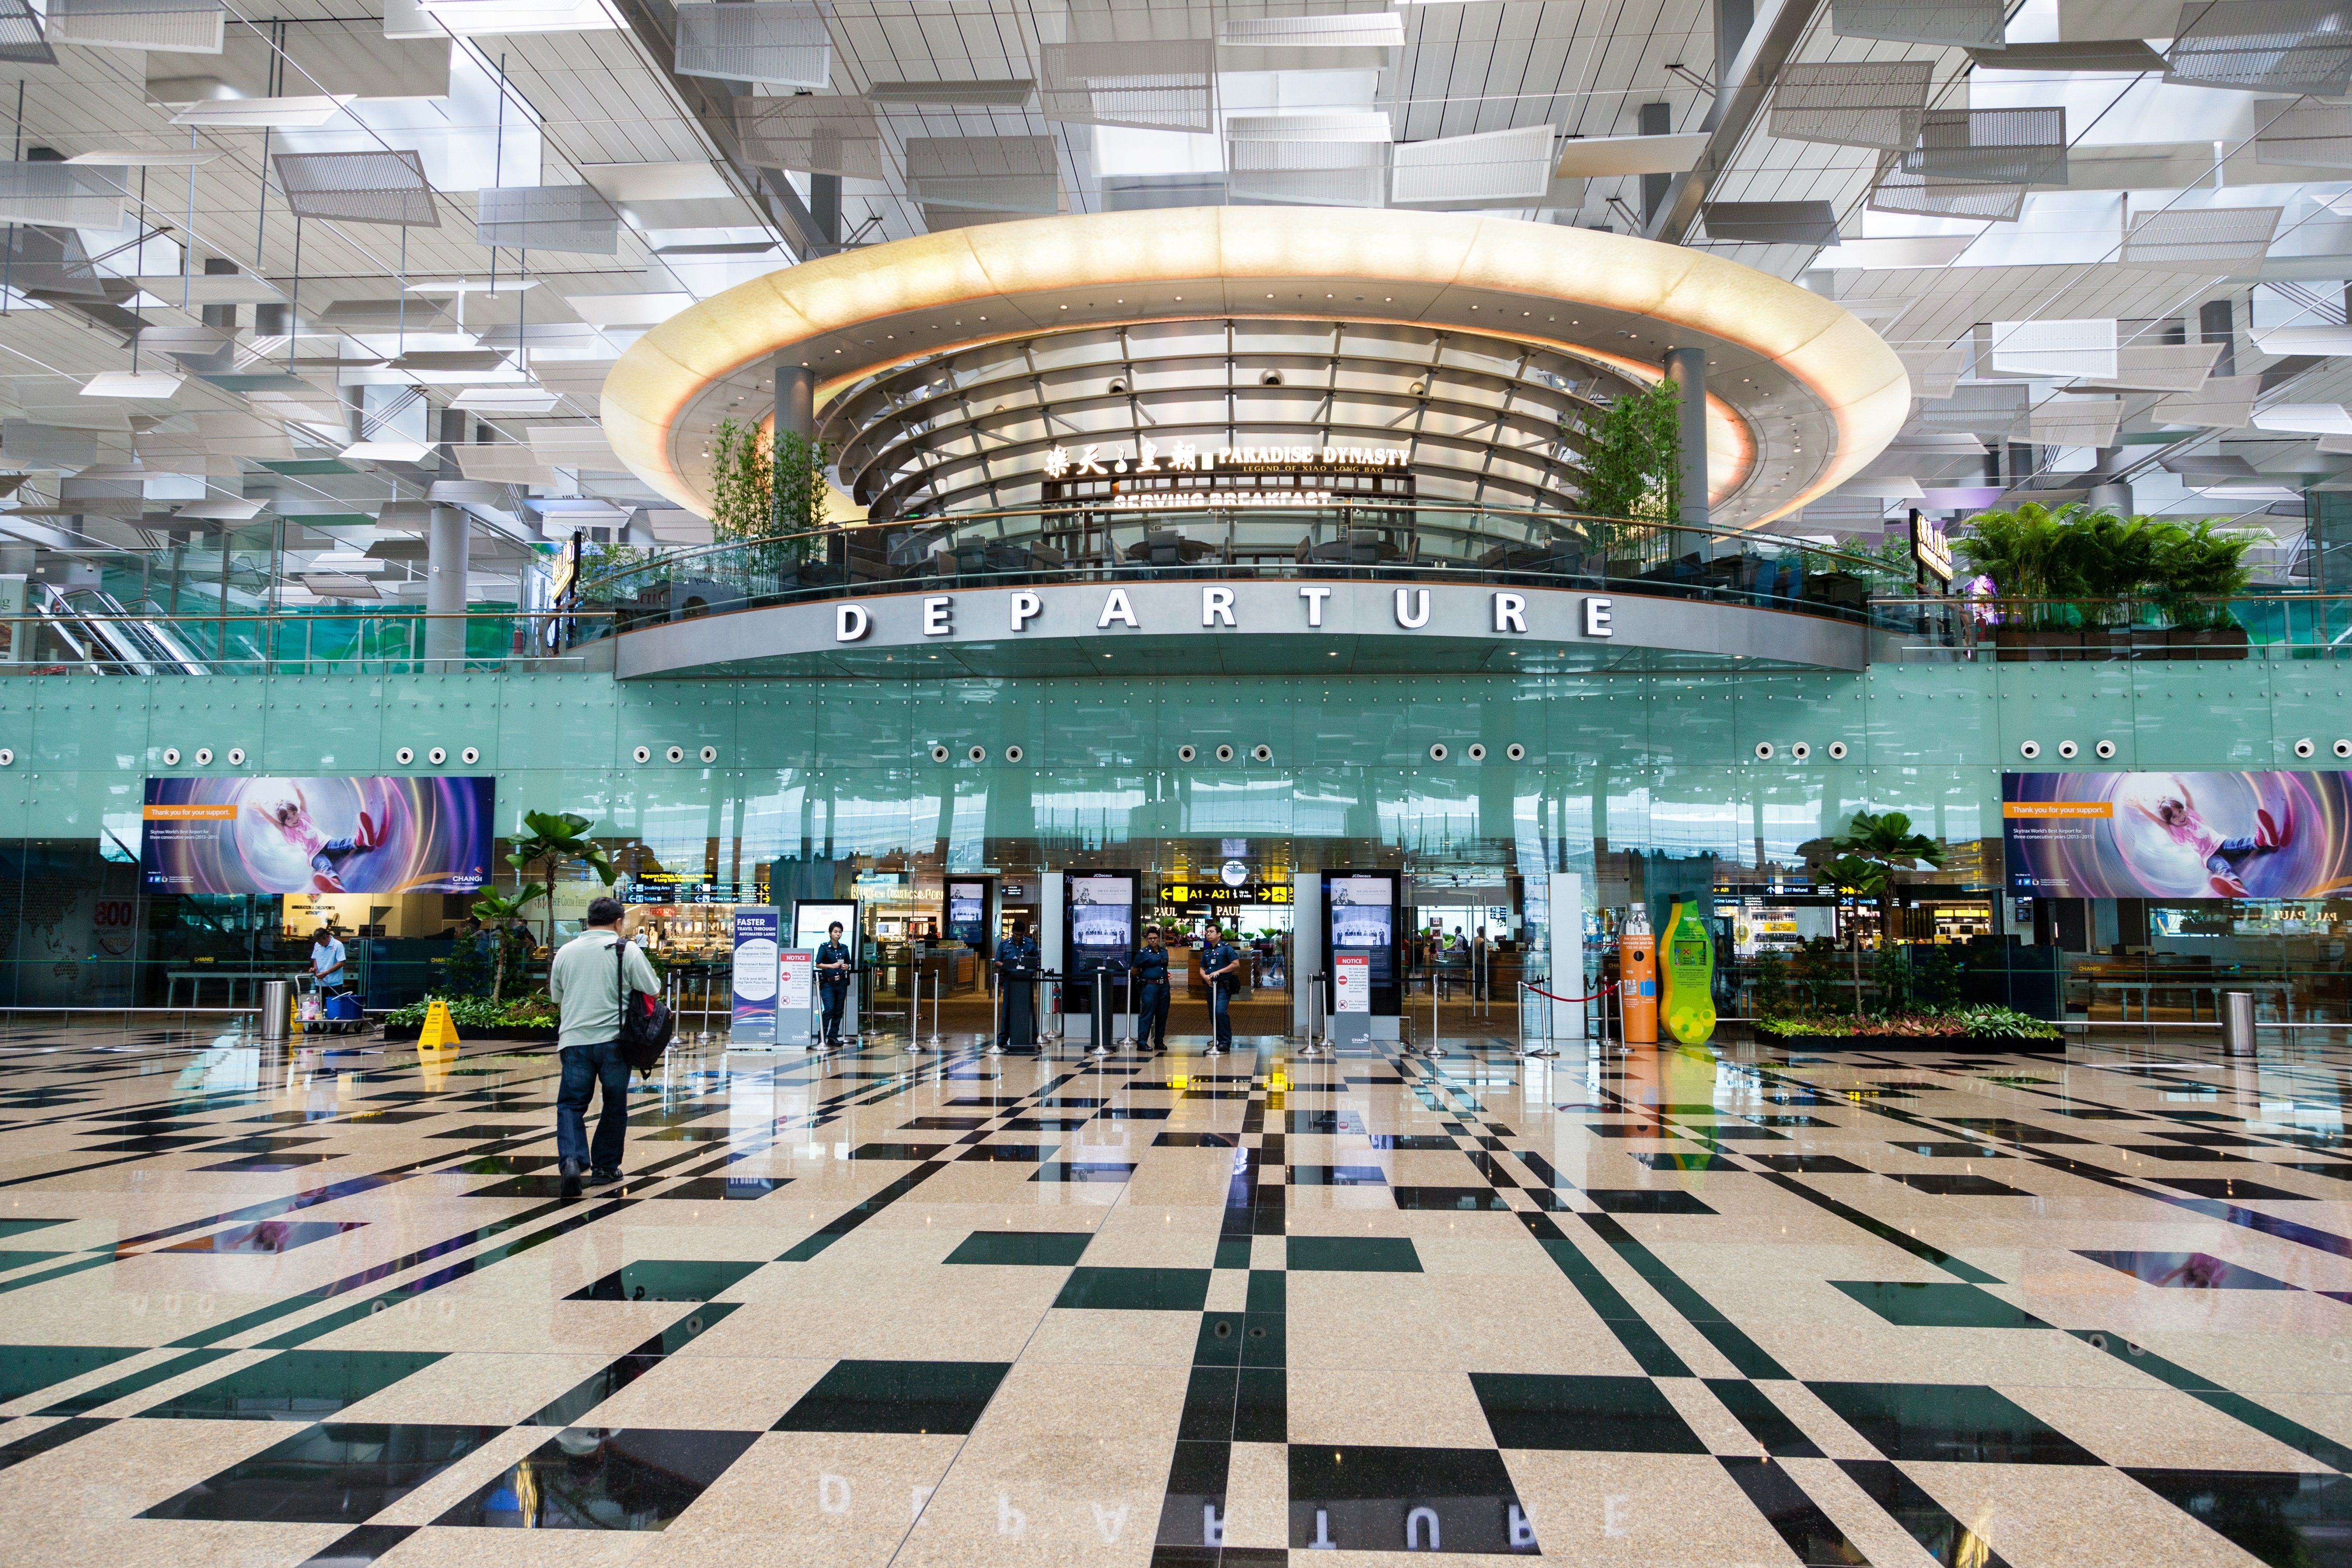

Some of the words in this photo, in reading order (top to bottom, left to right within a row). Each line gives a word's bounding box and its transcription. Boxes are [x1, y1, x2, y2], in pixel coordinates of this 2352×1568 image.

[1219, 446, 1314, 464] PARADISE
[1323, 446, 1411, 466] DYNASTY
[1114, 493, 1204, 508] SERVING
[1209, 492, 1331, 506] BREAKFAST
[836, 586, 1614, 643] DEPARTURE
[1190, 890, 1202, 899] A1
[1211, 889, 1230, 899] A21
[575, 896, 587, 907] TREES
[94, 901, 132, 926] 800
[1154, 907, 1177, 916] PAUL
[1216, 906, 1240, 916] PAUL
